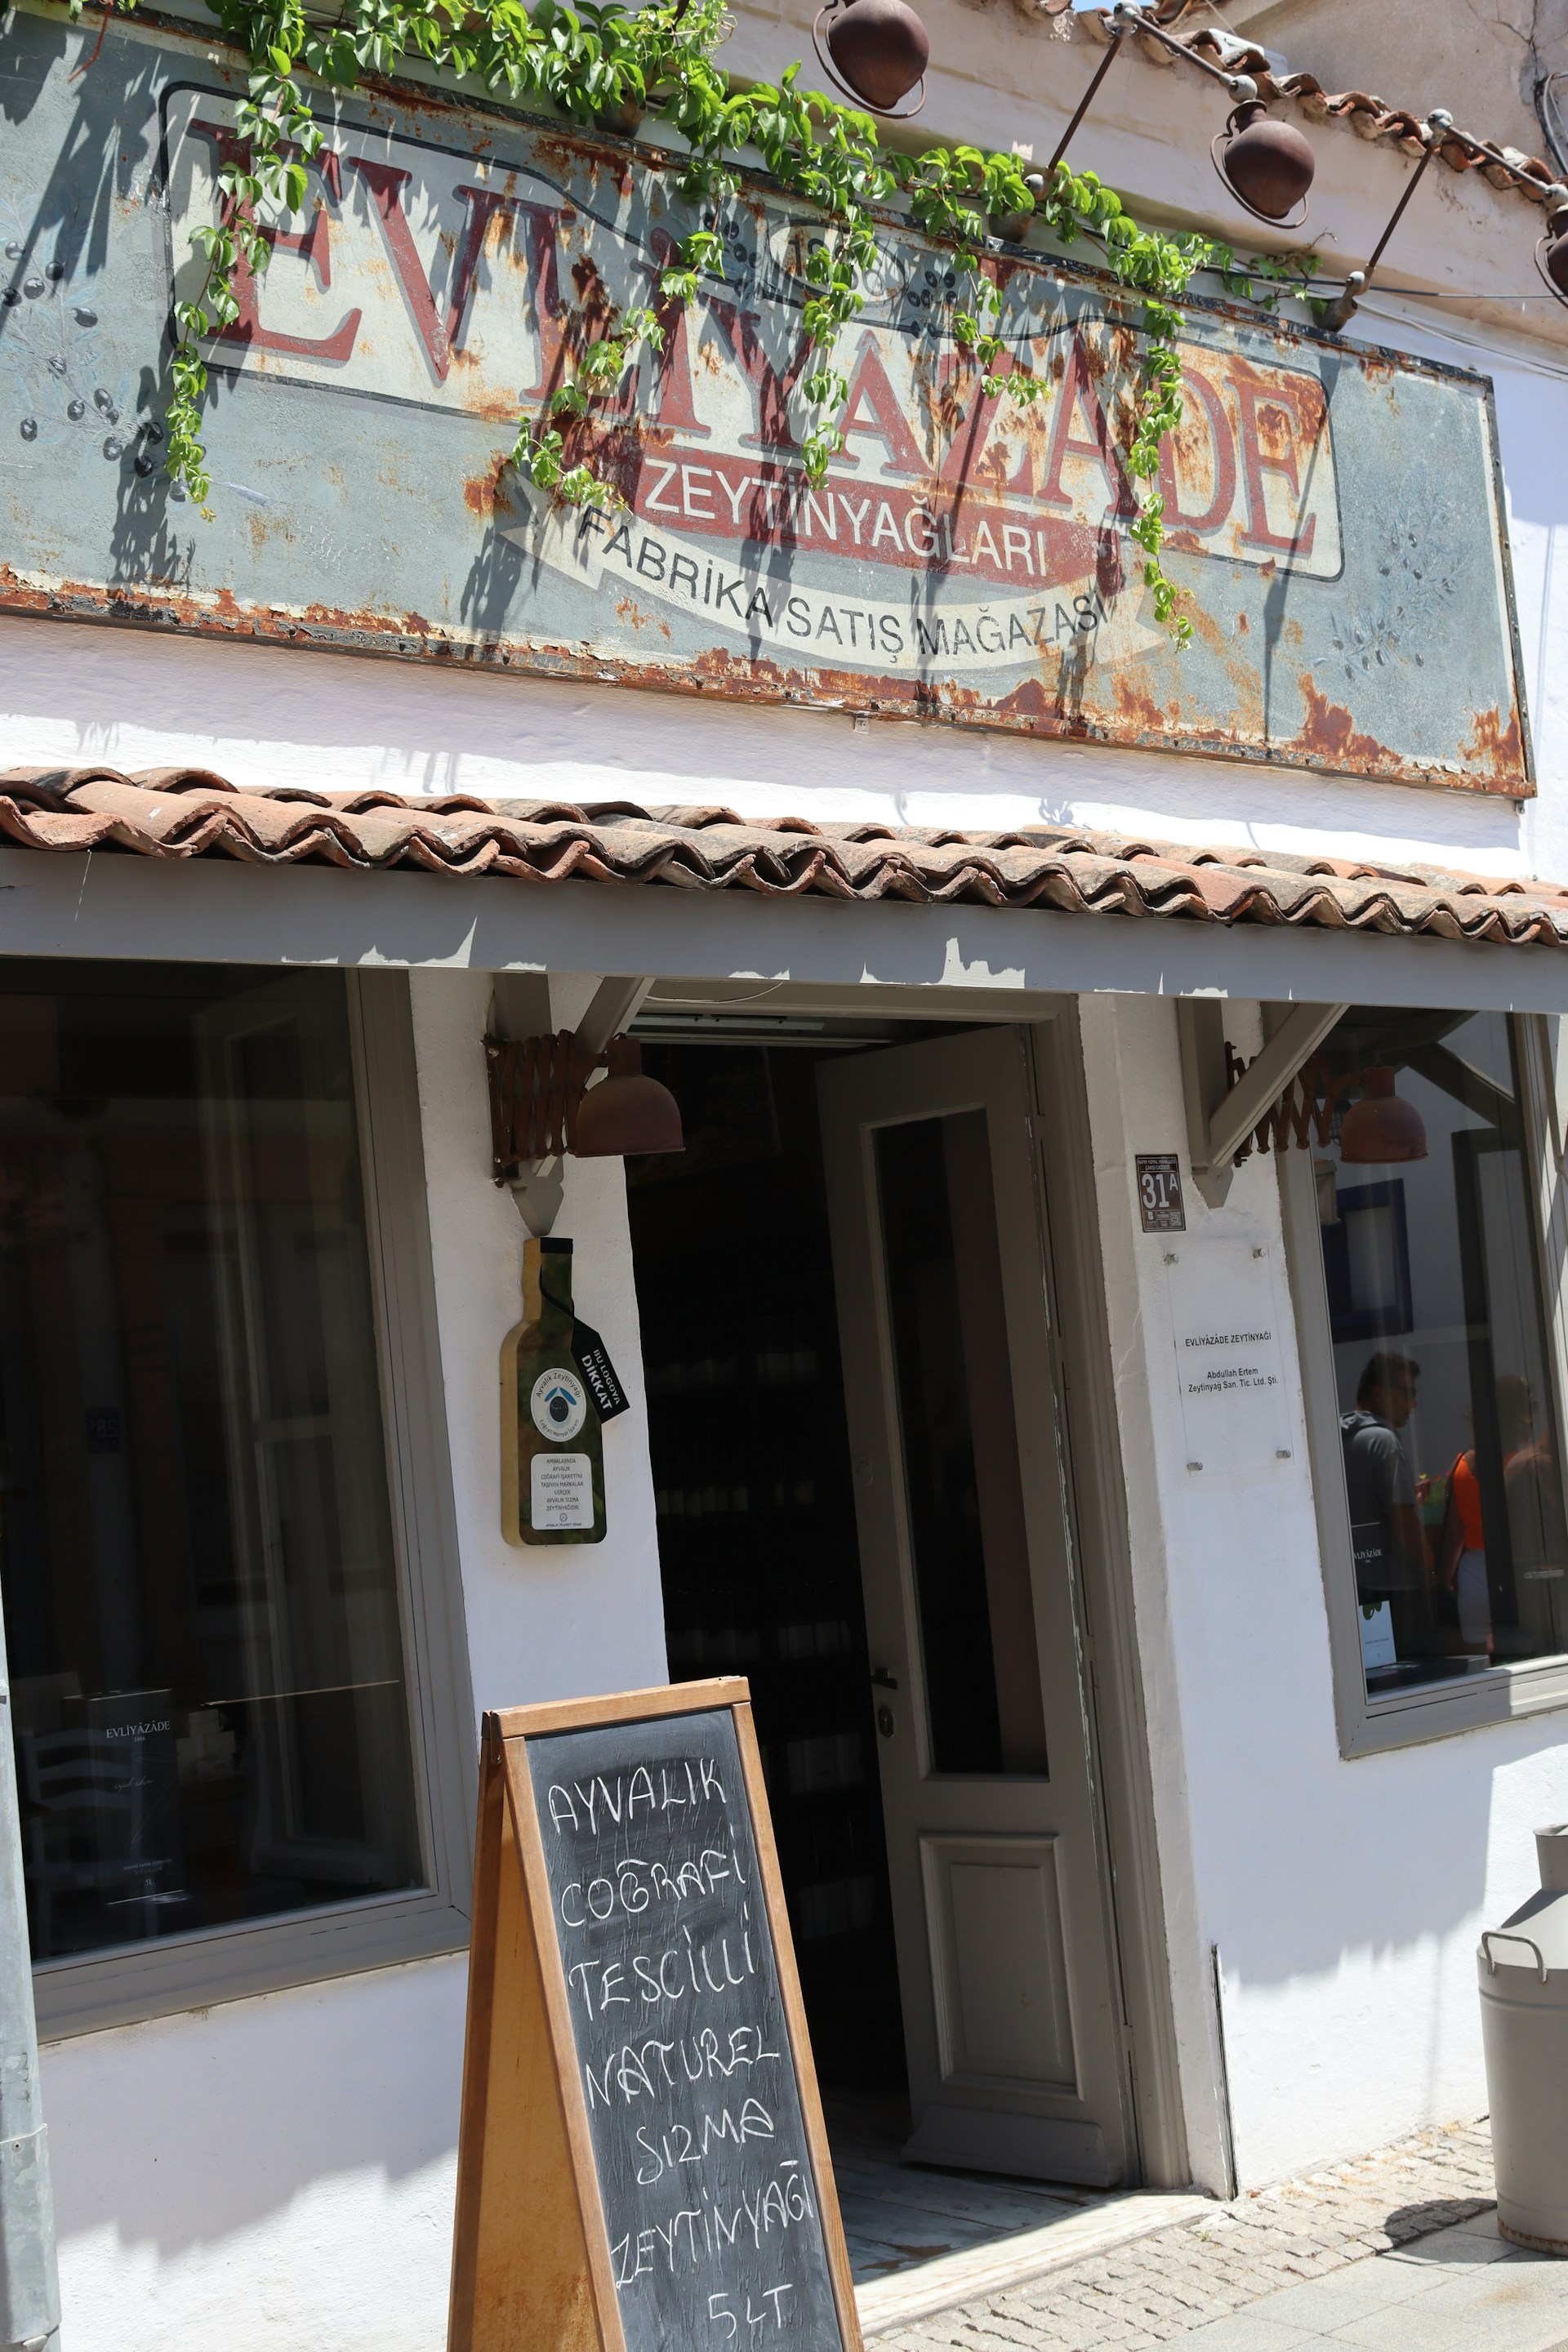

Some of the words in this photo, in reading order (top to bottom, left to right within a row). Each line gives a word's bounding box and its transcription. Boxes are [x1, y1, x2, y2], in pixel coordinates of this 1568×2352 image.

[644, 457, 1047, 577] ZEYTİNYAĞLARI
[577, 505, 774, 628] FABRİKA
[786, 596, 904, 664] SATIŞ
[915, 593, 1109, 656] MAĞAZASI
[593, 1348, 604, 1363] BU
[600, 1365, 621, 1405] LOGOYA
[1207, 1369, 1237, 1379] Abdullah
[1238, 1368, 1258, 1376] Ertem
[1231, 1331, 1272, 1343] ZEYTİNYAĞI
[536, 1375, 552, 1398] Ayvalık
[581, 1355, 612, 1409] DİKKAT
[1188, 1381, 1222, 1393] Zeytinyağ
[1223, 1380, 1238, 1389] San.
[1240, 1379, 1252, 1388] Tic.
[1253, 1377, 1266, 1386] Ltd.
[1267, 1375, 1279, 1386] Şti.
[548, 1757, 727, 1836] AYVALIK
[561, 1822, 746, 1927] COĞRAFİ
[568, 1900, 755, 2021] TESCİLLİ
[586, 2025, 780, 2109] NATUREL
[610, 2159, 814, 2289] ZEYTİNYAĞI
